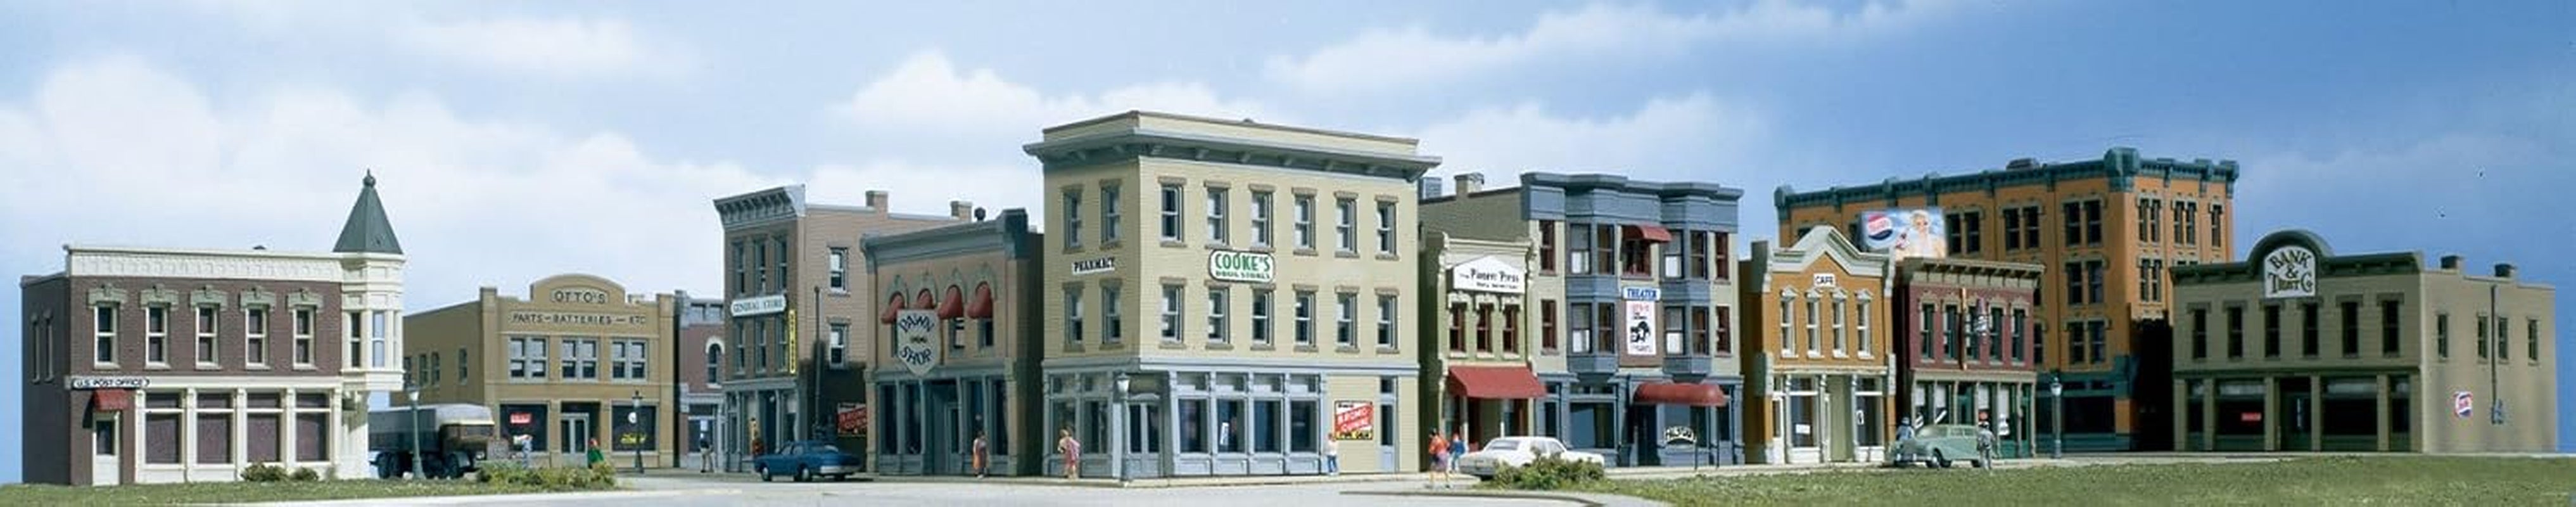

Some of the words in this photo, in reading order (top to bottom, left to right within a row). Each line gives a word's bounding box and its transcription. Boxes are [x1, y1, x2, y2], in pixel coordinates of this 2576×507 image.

[1074, 257, 1115, 273] PHARMACY
[1215, 254, 1271, 272] COOKE'S
[2269, 249, 2311, 269] BANK
[2285, 263, 2299, 279] &
[1815, 275, 1834, 285] CAFE
[554, 290, 606, 305] OTTO'S
[1627, 288, 1657, 298] THEATER
[899, 315, 934, 332] PAWN
[900, 346, 933, 365] SHOP
